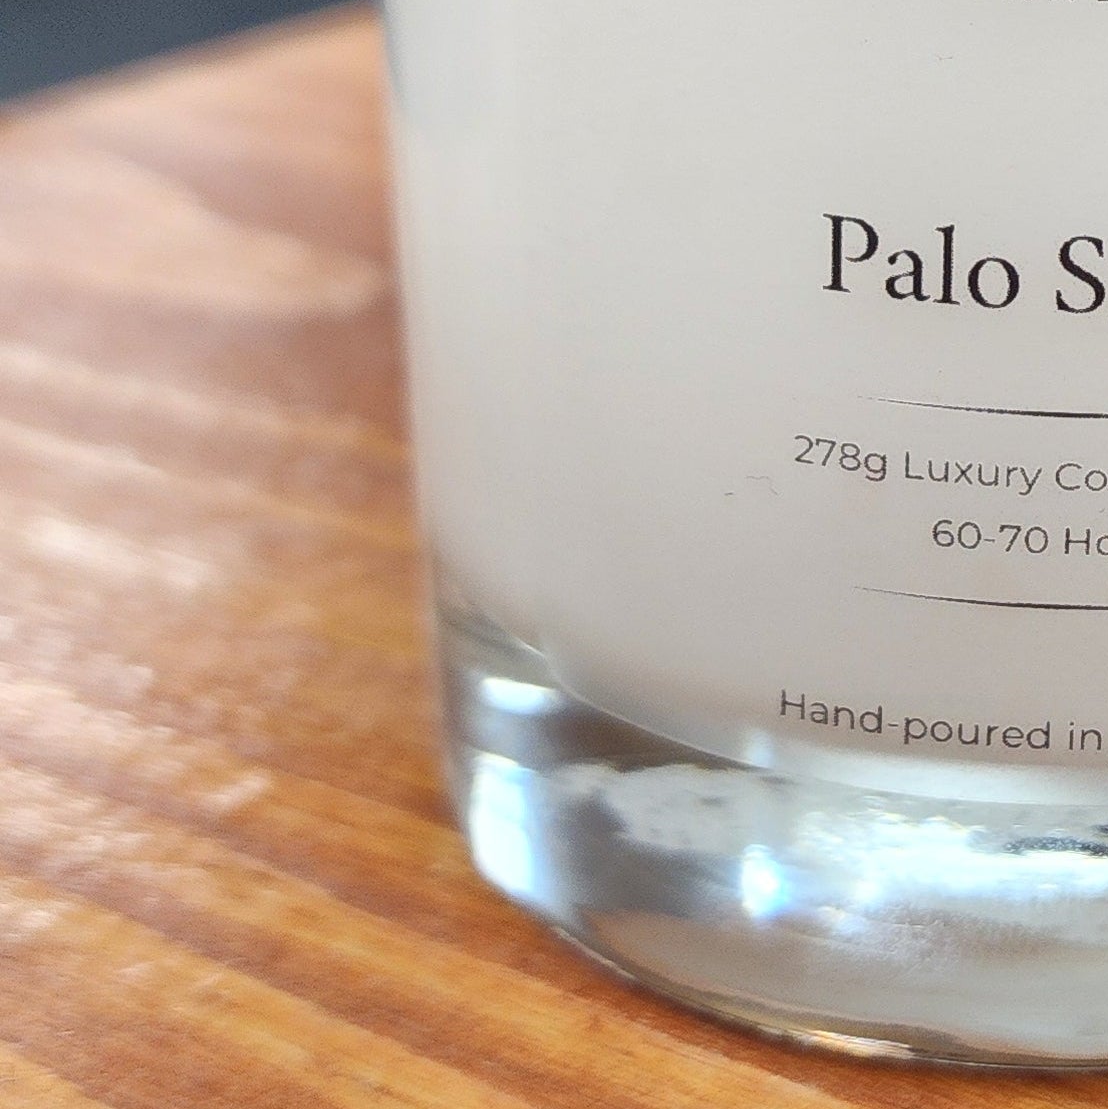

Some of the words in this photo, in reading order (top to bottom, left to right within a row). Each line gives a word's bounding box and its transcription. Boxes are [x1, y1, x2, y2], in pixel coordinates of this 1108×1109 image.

[823, 213, 1020, 309] Palo
[795, 435, 887, 482] 278g
[905, 452, 1042, 496] Luxury
[932, 520, 1048, 553] 60-70
[778, 690, 1050, 749] Hand-poured
[1069, 722, 1102, 750] in
